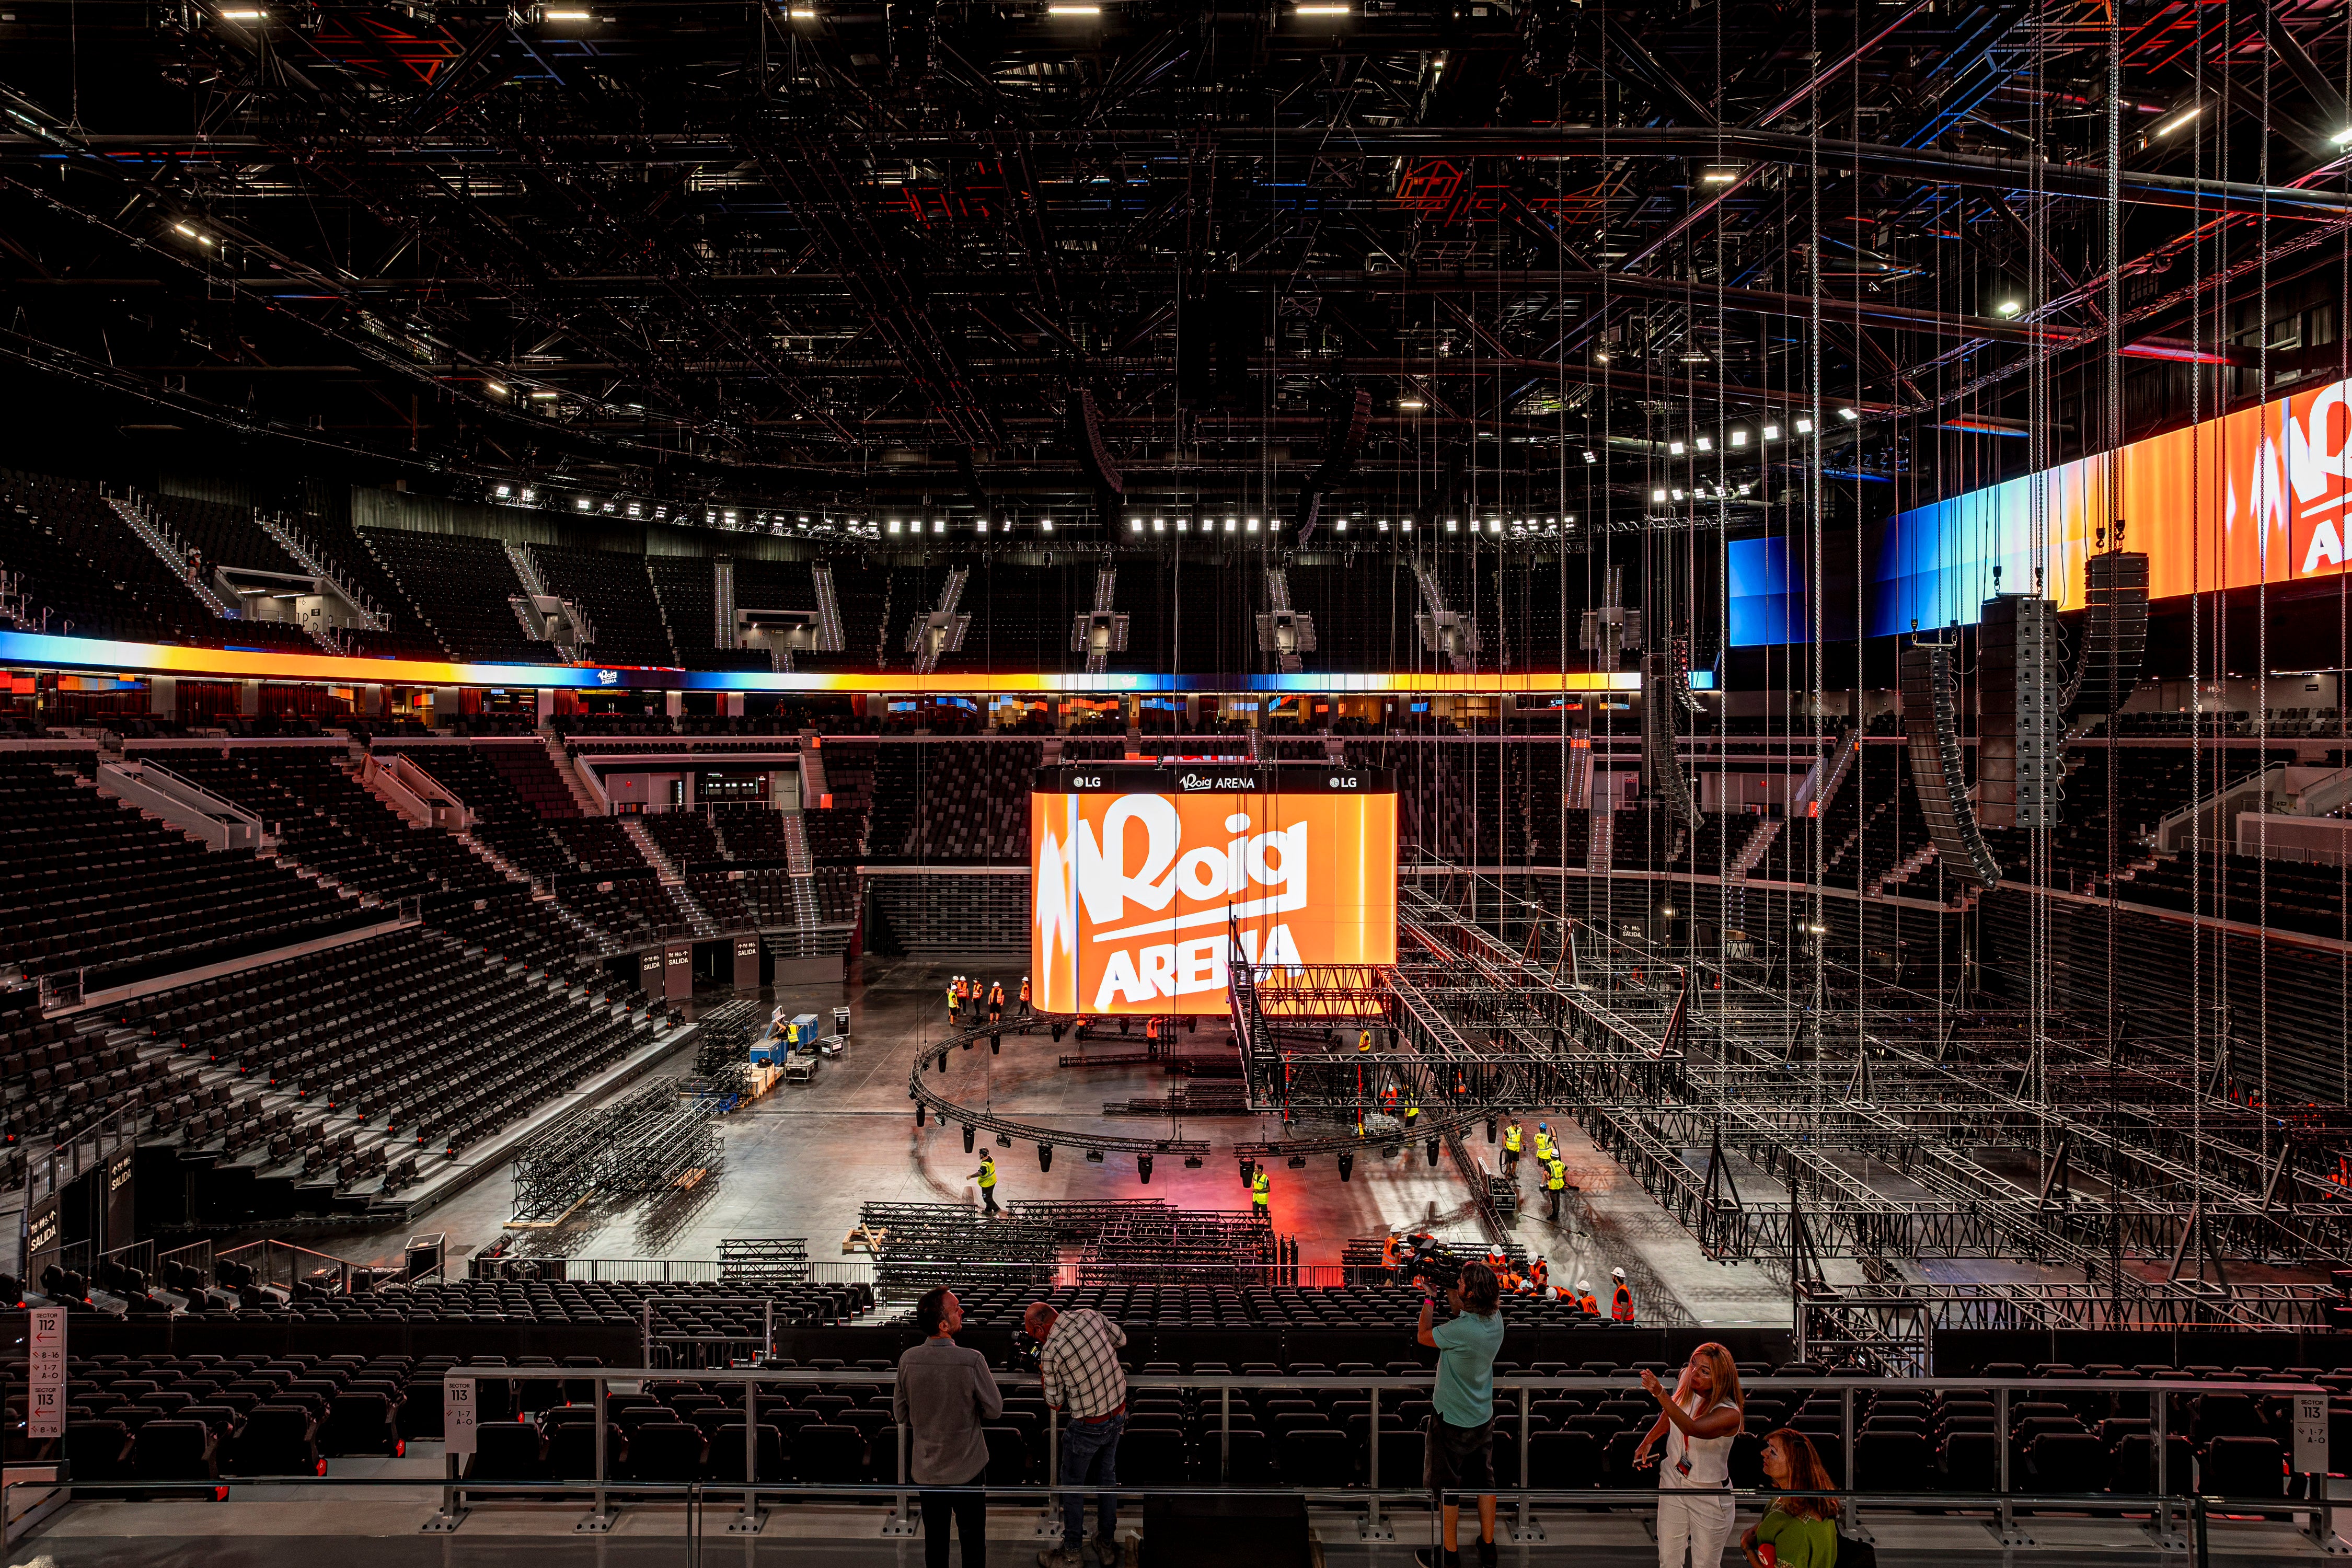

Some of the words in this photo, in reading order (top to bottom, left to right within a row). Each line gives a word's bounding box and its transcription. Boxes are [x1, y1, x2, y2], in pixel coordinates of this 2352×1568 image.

[597, 670, 617, 681] Roig
[1085, 777, 1101, 787] LG
[1179, 774, 1212, 791] Roig
[1215, 778, 1255, 788] ARENA
[1341, 777, 1357, 788] LG
[1077, 794, 1307, 943] Roig
[643, 962, 660, 971] SALIDA
[111, 1168, 132, 1191] SALIDA
[30, 1225, 56, 1252] SALIDA
[39, 1320, 55, 1331] 112
[38, 1394, 54, 1405] 113
[452, 1390, 468, 1401] 113
[2303, 1406, 2321, 1418] 113
